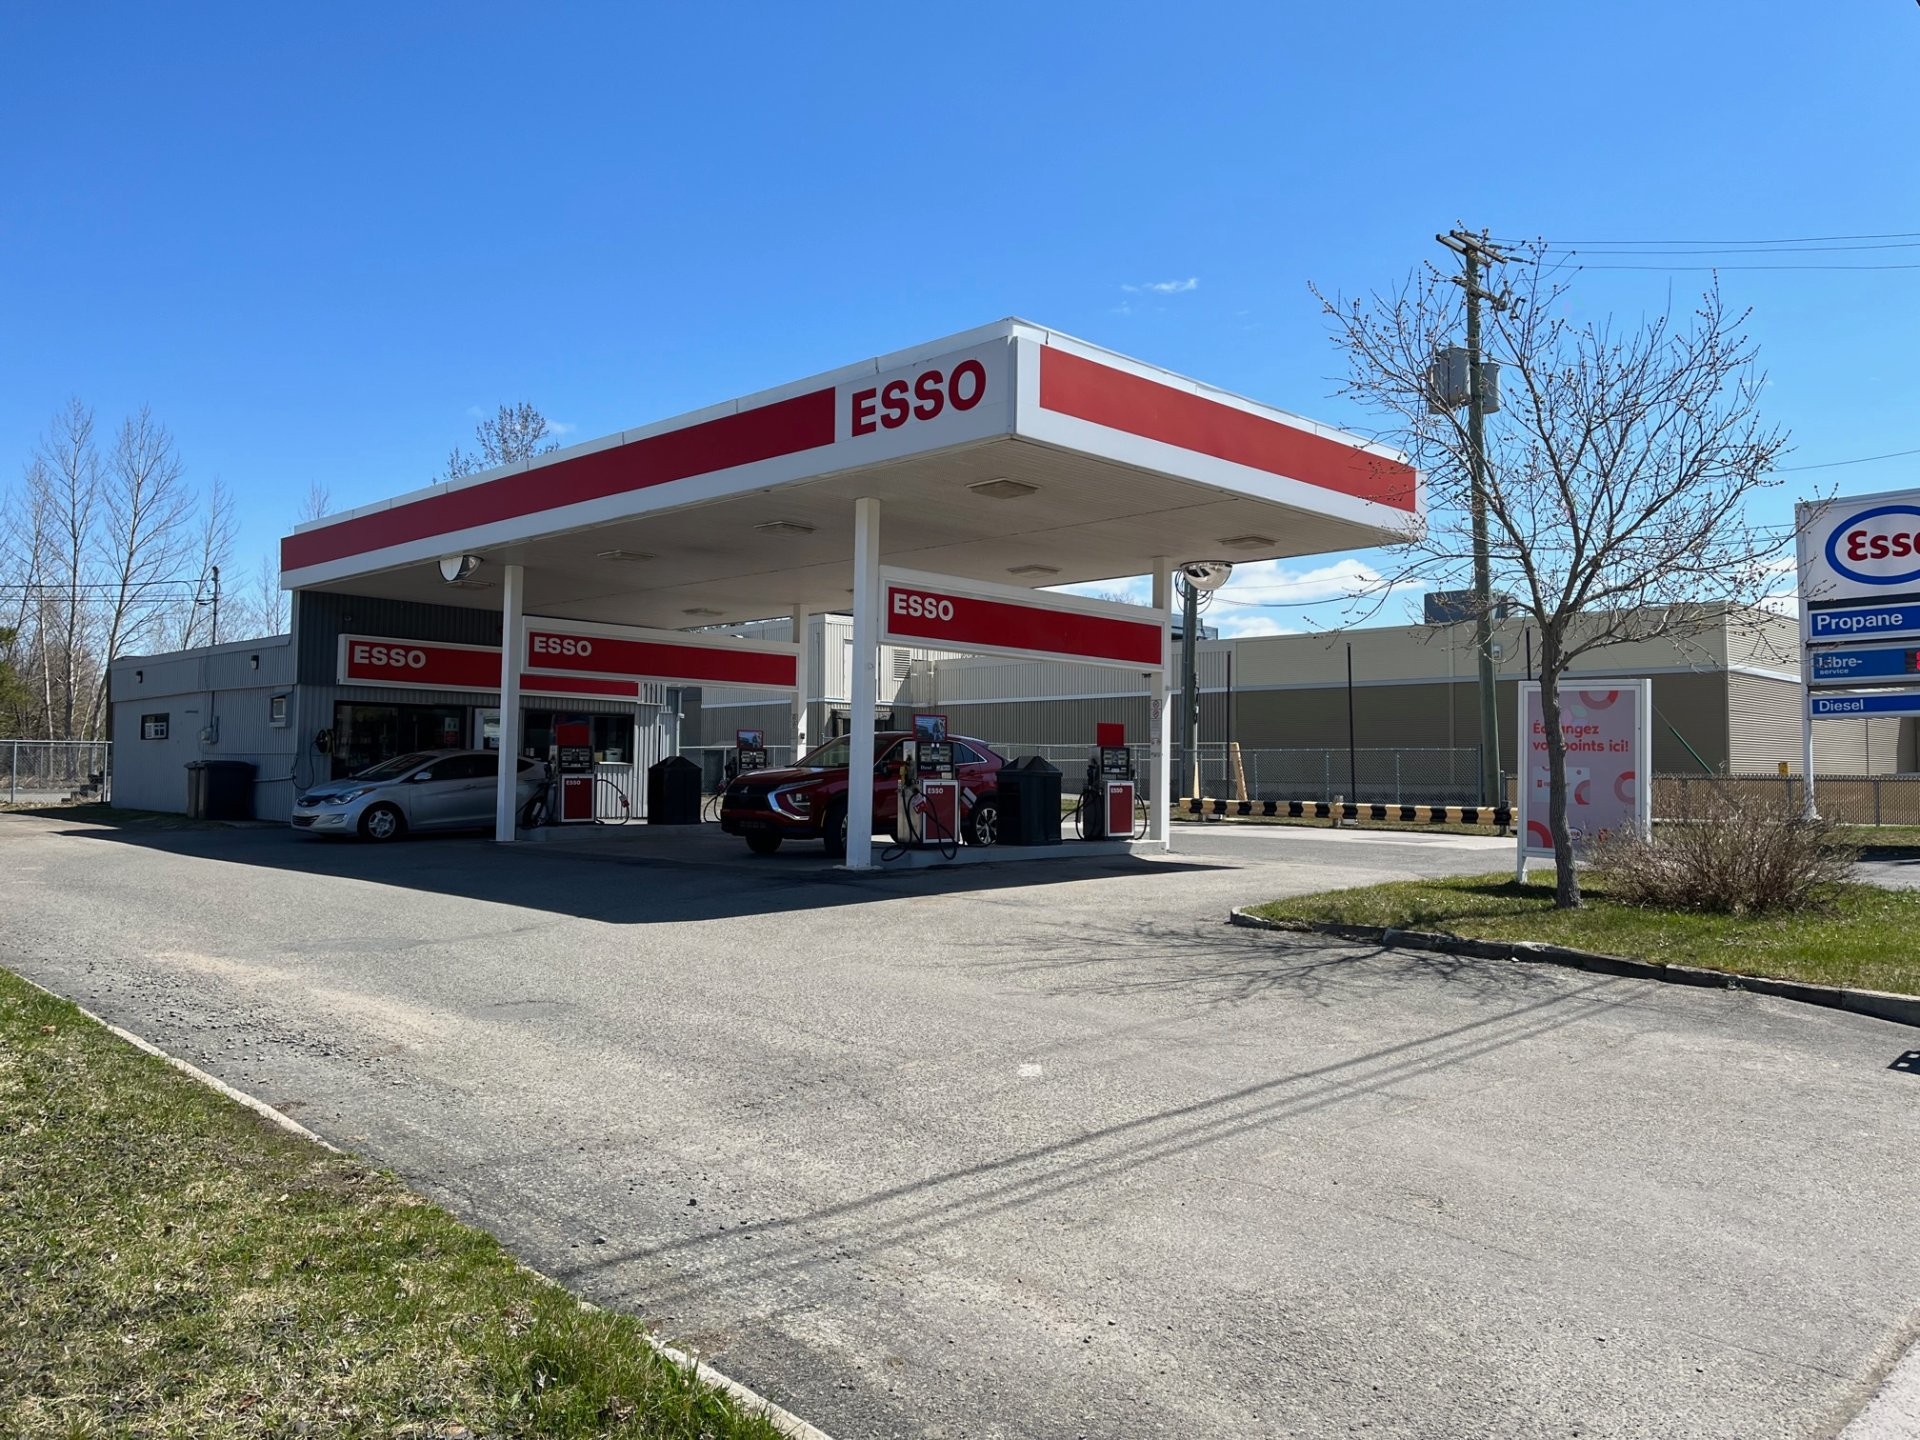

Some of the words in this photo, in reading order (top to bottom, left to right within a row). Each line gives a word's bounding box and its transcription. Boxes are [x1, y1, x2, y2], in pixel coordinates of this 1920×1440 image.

[851, 359, 987, 438] ESSO
[893, 593, 954, 621] ESSO
[1817, 613, 1903, 632] Propane
[353, 645, 427, 669] ESSO
[533, 636, 592, 657] ESSO
[1819, 699, 1864, 712] Diesel
[1532, 742, 1549, 751] vo
[1609, 739, 1629, 752] ici!
